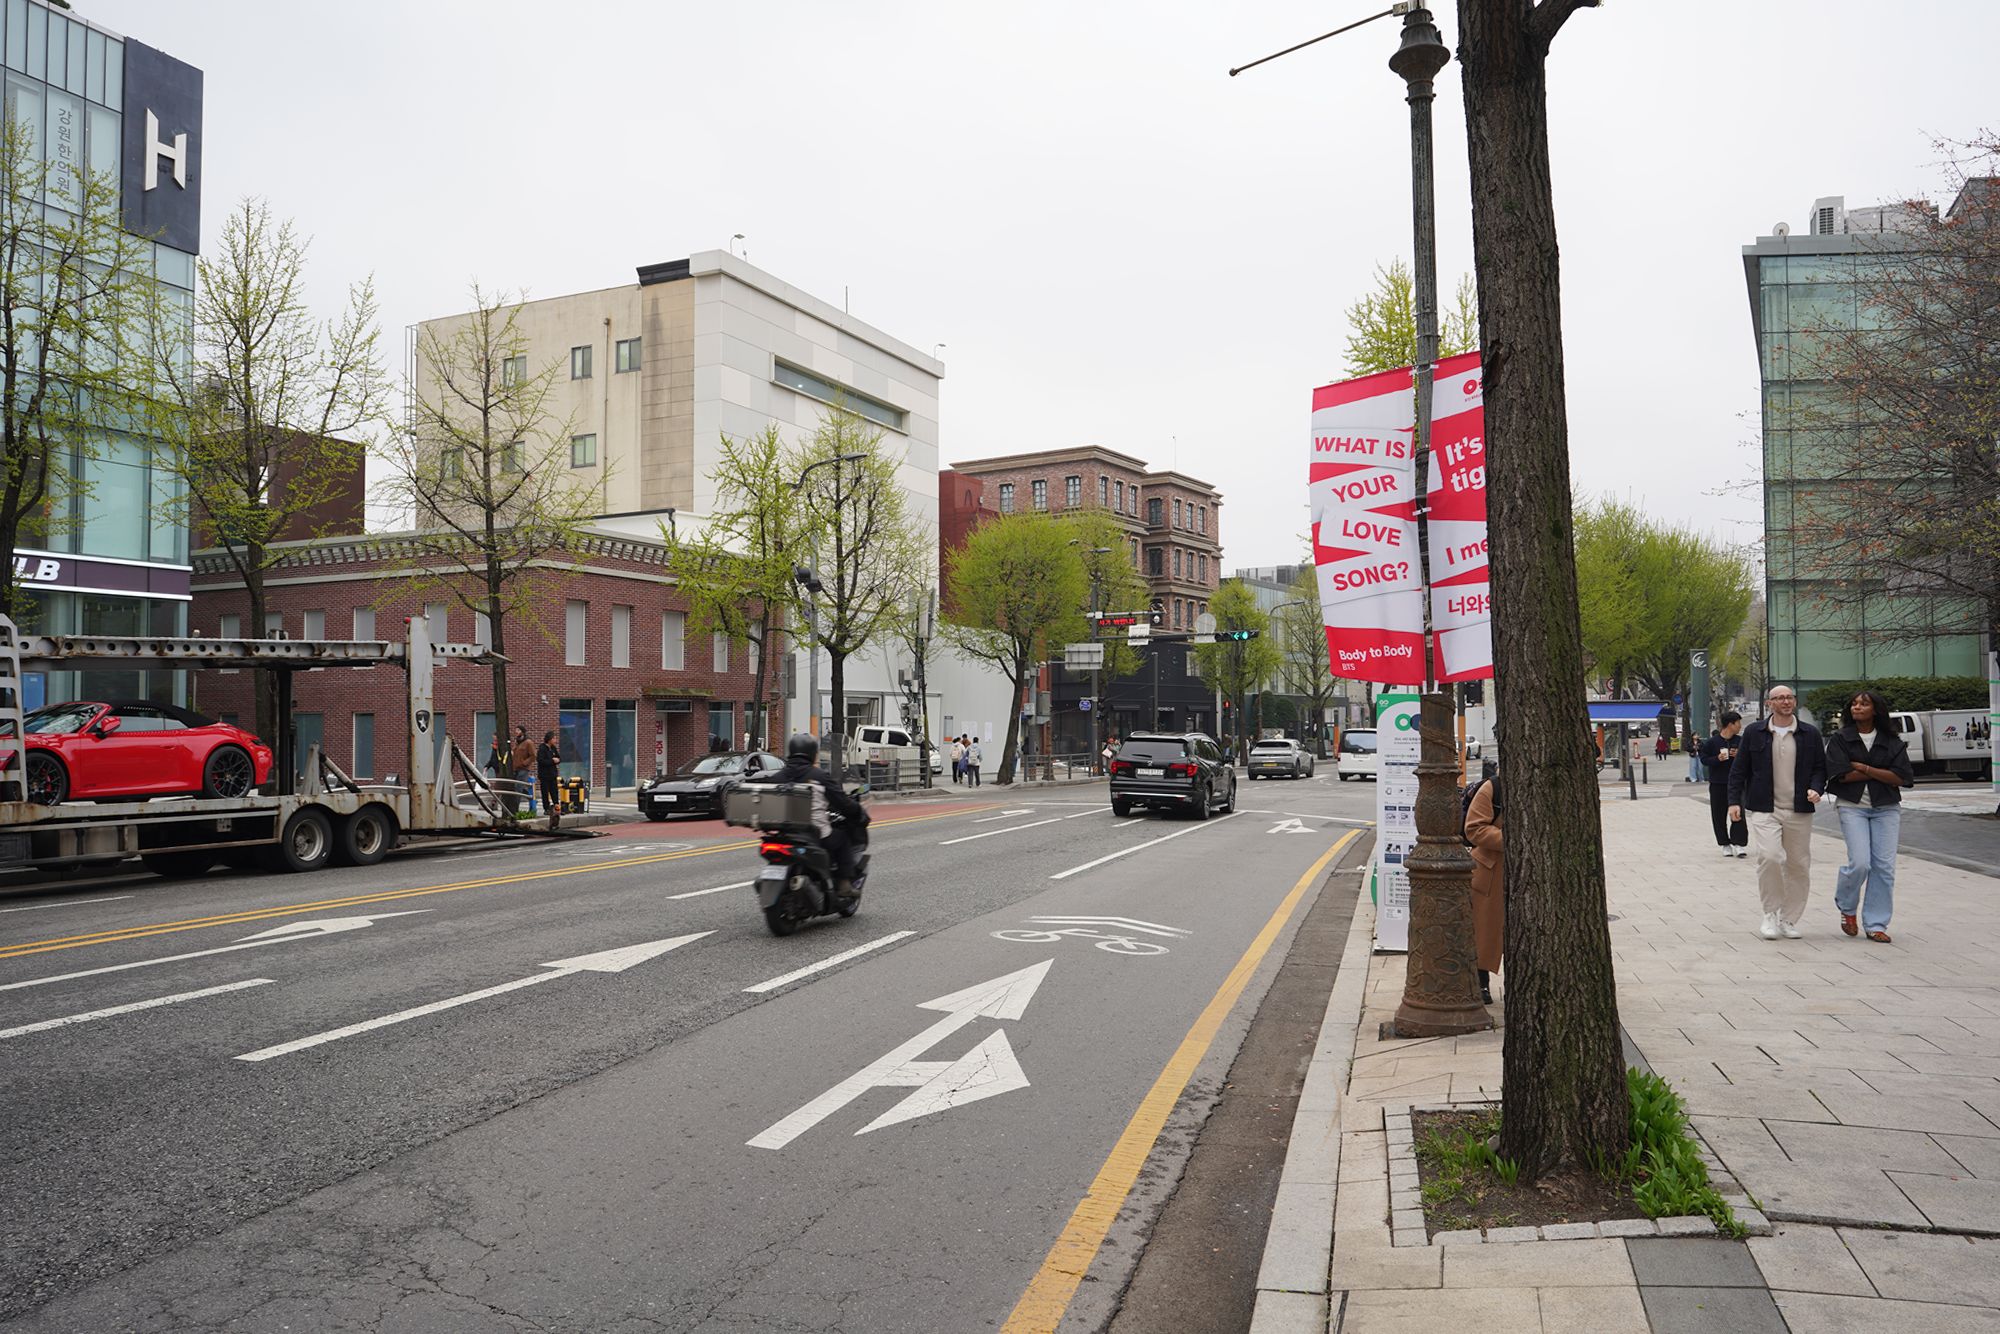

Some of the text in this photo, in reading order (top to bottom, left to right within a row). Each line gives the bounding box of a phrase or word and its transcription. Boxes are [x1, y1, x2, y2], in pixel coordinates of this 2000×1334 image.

[57, 108, 73, 192] 강원한의원
[144, 107, 187, 191] H
[1315, 437, 1405, 458] WHAT IS
[1445, 436, 1483, 466] It's
[1331, 474, 1398, 503] YOUR
[1343, 519, 1401, 546] LOVE
[12, 557, 60, 581] LB
[1446, 547, 1455, 565] I
[1333, 561, 1409, 591] SONG?
[1338, 644, 1412, 662] Body to Body
[1342, 663, 1355, 671] BTS
